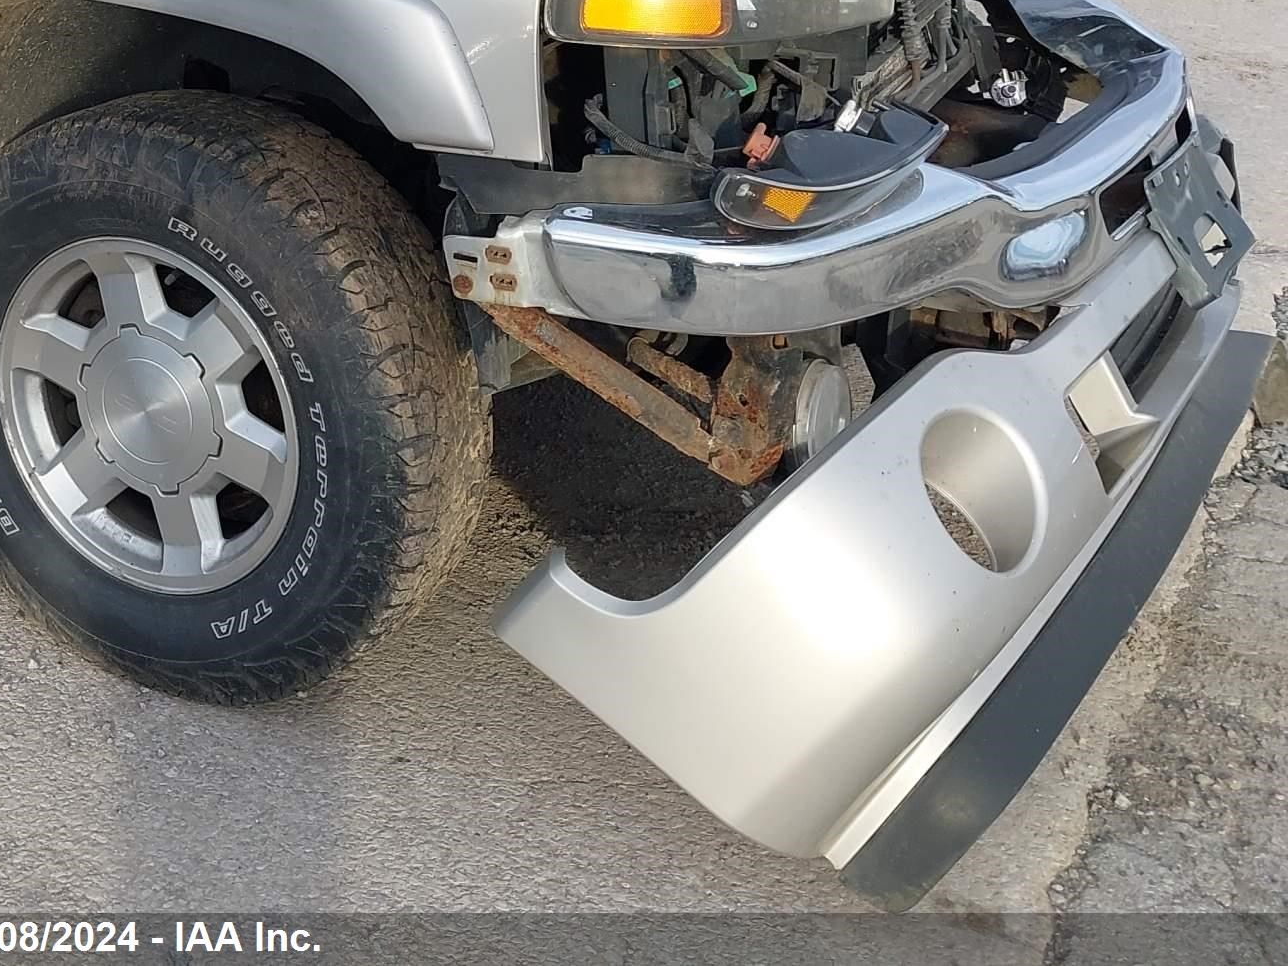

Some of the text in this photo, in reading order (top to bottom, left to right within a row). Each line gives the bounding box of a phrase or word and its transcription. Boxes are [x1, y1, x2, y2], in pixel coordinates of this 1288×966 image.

[168, 217, 328, 639] Rugged Terrain T/A
